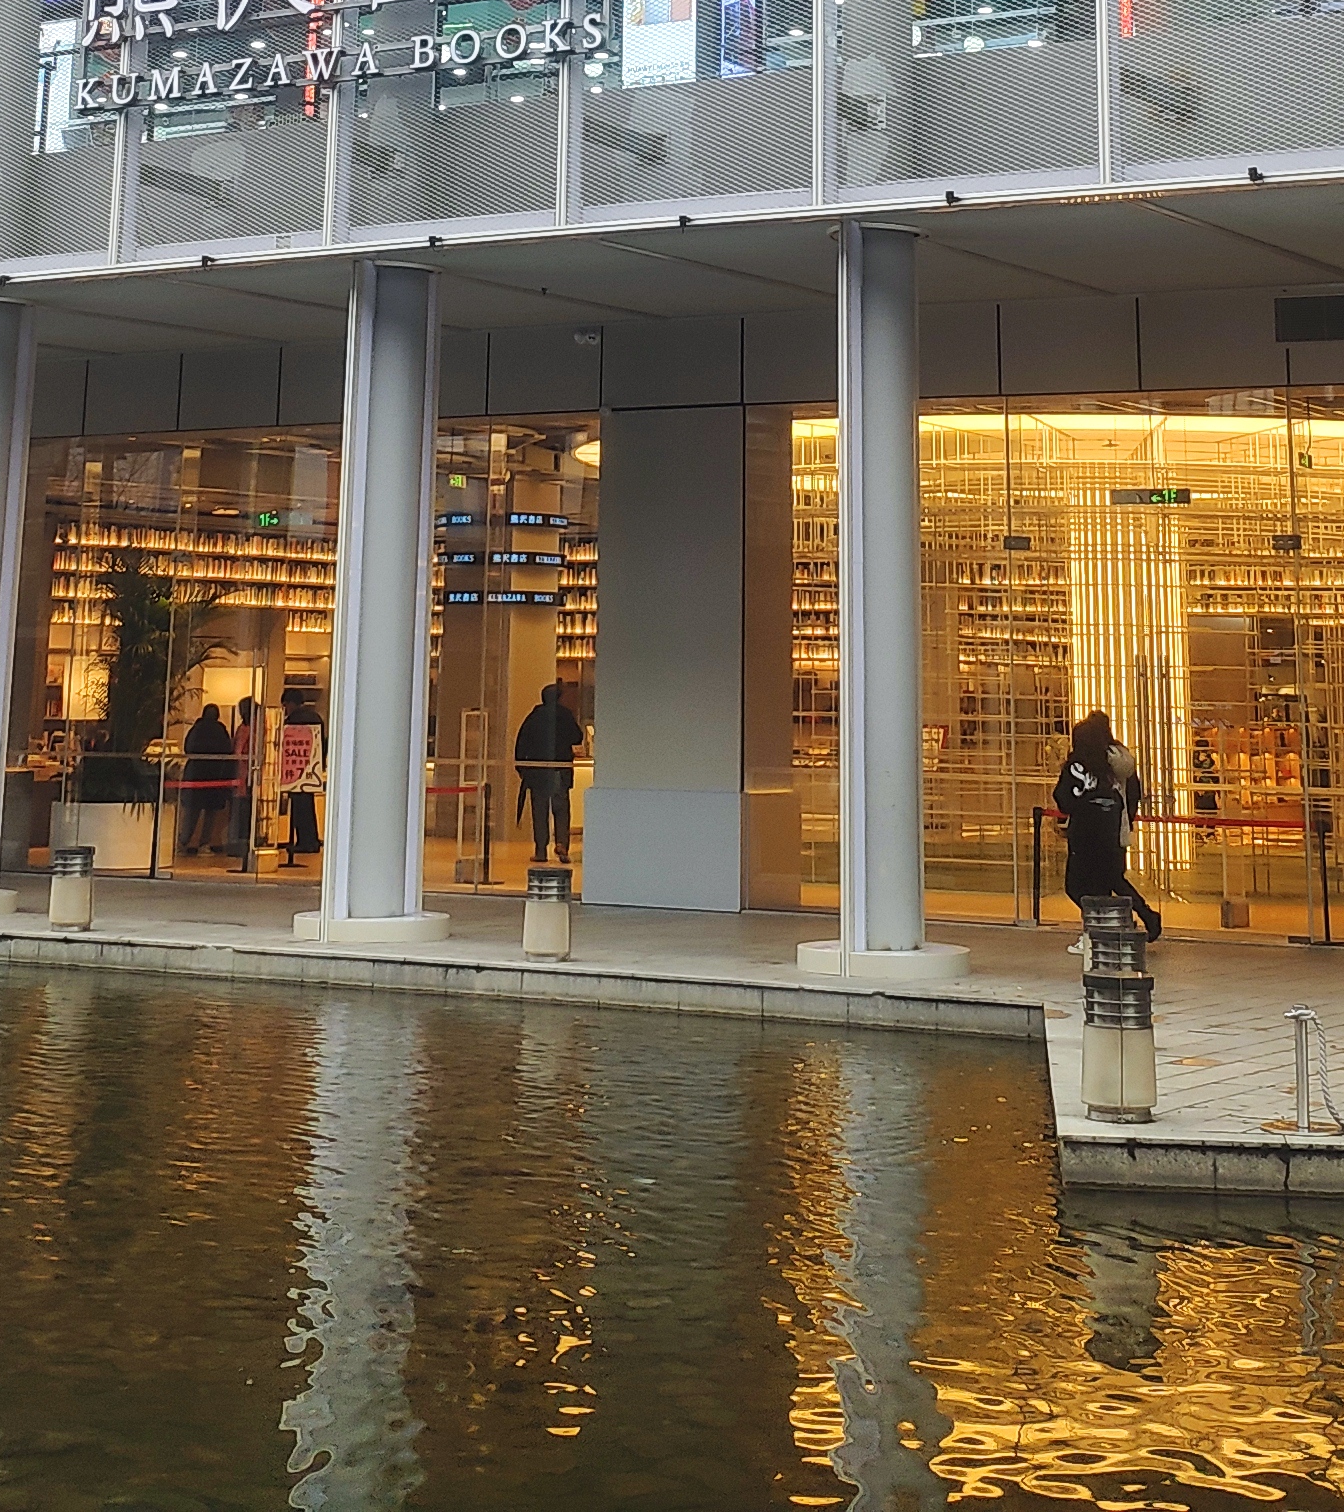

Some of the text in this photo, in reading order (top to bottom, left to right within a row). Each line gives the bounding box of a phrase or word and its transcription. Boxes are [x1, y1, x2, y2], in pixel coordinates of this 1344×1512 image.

[74, 12, 605, 111] KUMAZAWA BOOKS
[284, 749, 310, 757] SALE
